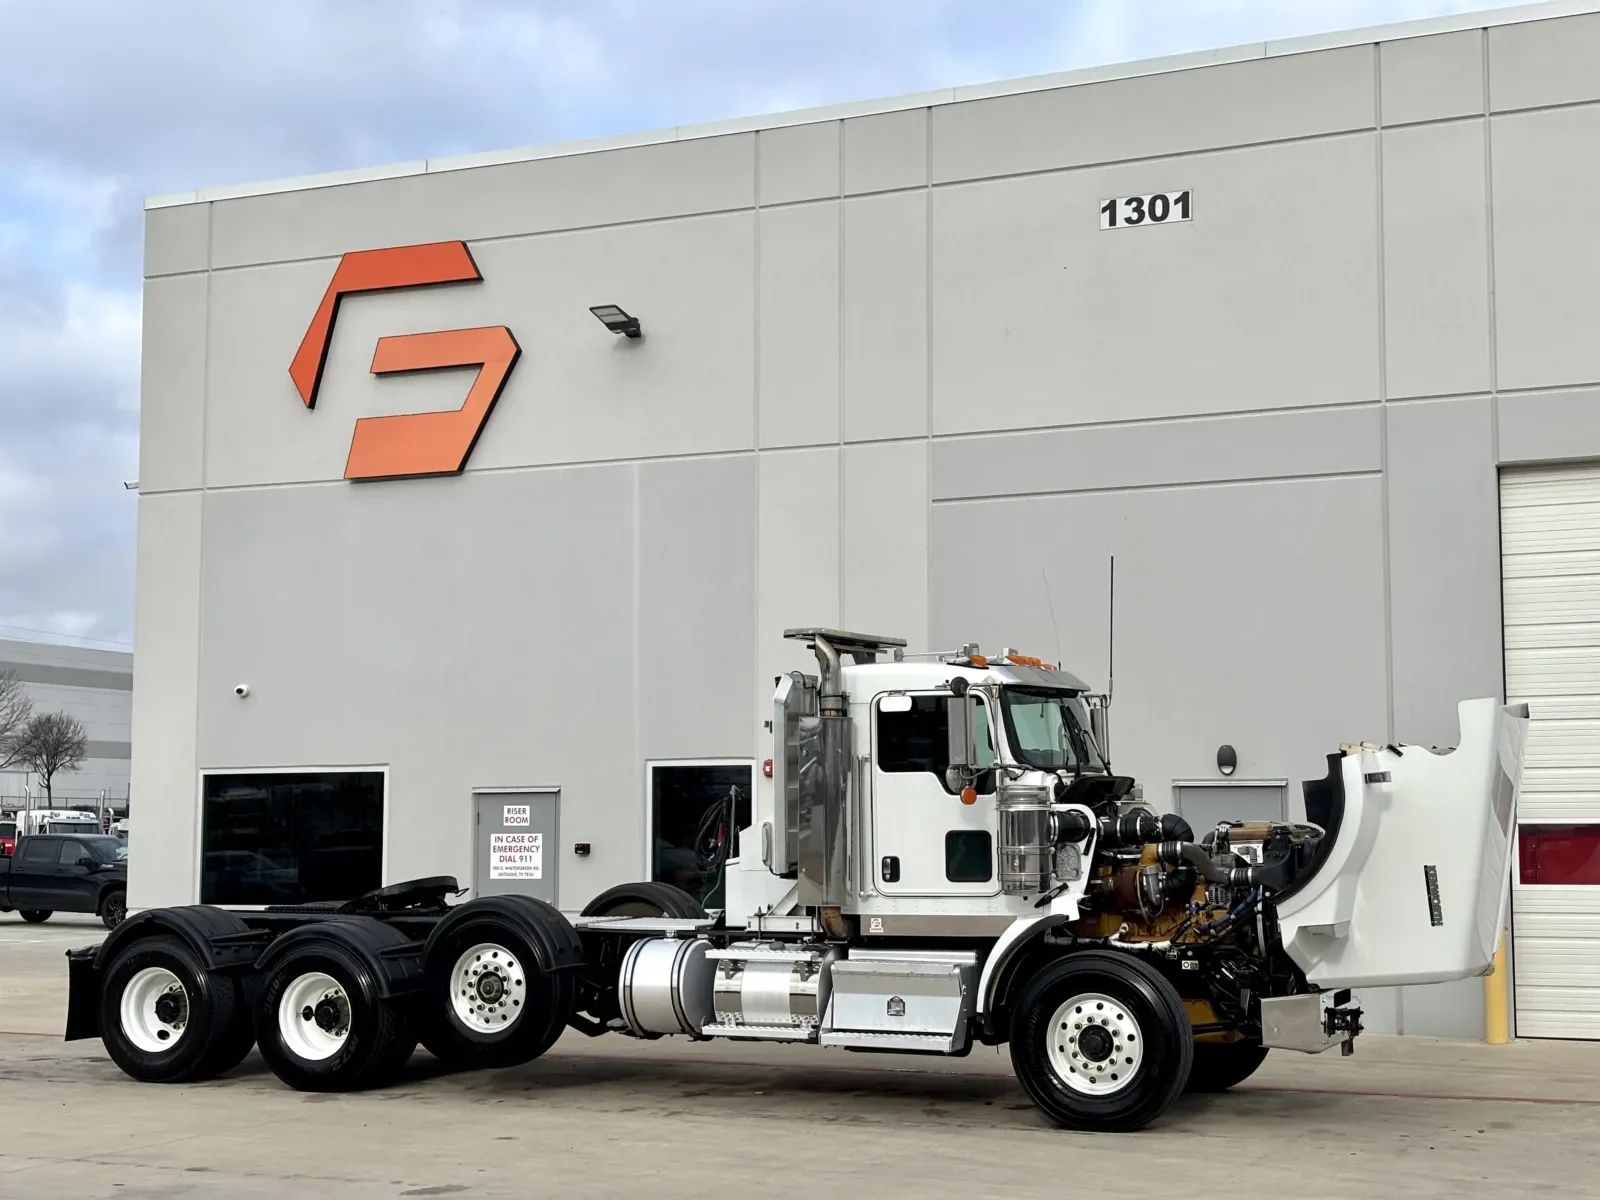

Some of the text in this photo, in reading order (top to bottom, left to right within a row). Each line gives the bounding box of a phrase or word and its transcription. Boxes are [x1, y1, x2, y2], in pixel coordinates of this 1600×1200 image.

[1101, 191, 1190, 227] 1301
[506, 807, 527, 815] RISER
[504, 816, 529, 824] ROOM
[494, 835, 539, 843] IN CASE OF
[492, 845, 540, 853] EMERGENCY
[499, 855, 532, 863] DIAL 911
[1424, 865, 1443, 926] KENWORTH
